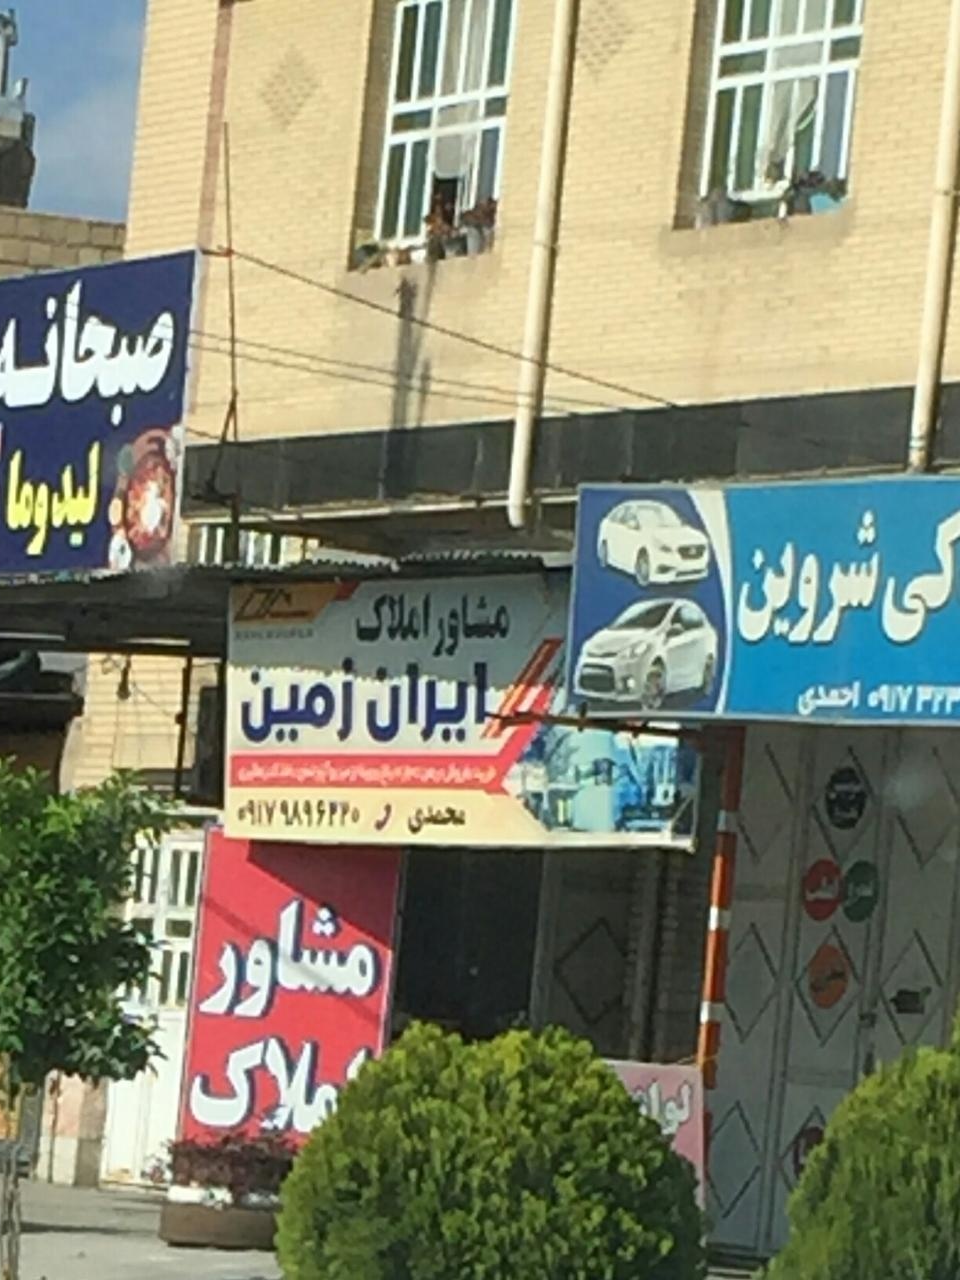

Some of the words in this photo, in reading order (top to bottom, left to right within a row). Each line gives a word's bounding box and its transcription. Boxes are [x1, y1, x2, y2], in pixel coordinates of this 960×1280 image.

[6, 442, 100, 556] لیدوما
[737, 510, 880, 642] شروین
[356, 592, 431, 641] املاک
[432, 593, 510, 657] مشاور
[240, 657, 355, 742] زمین
[366, 662, 487, 742] ایران
[798, 680, 861, 717] احمدی
[407, 804, 466, 834] محمدی
[199, 898, 375, 1018] مشاور
